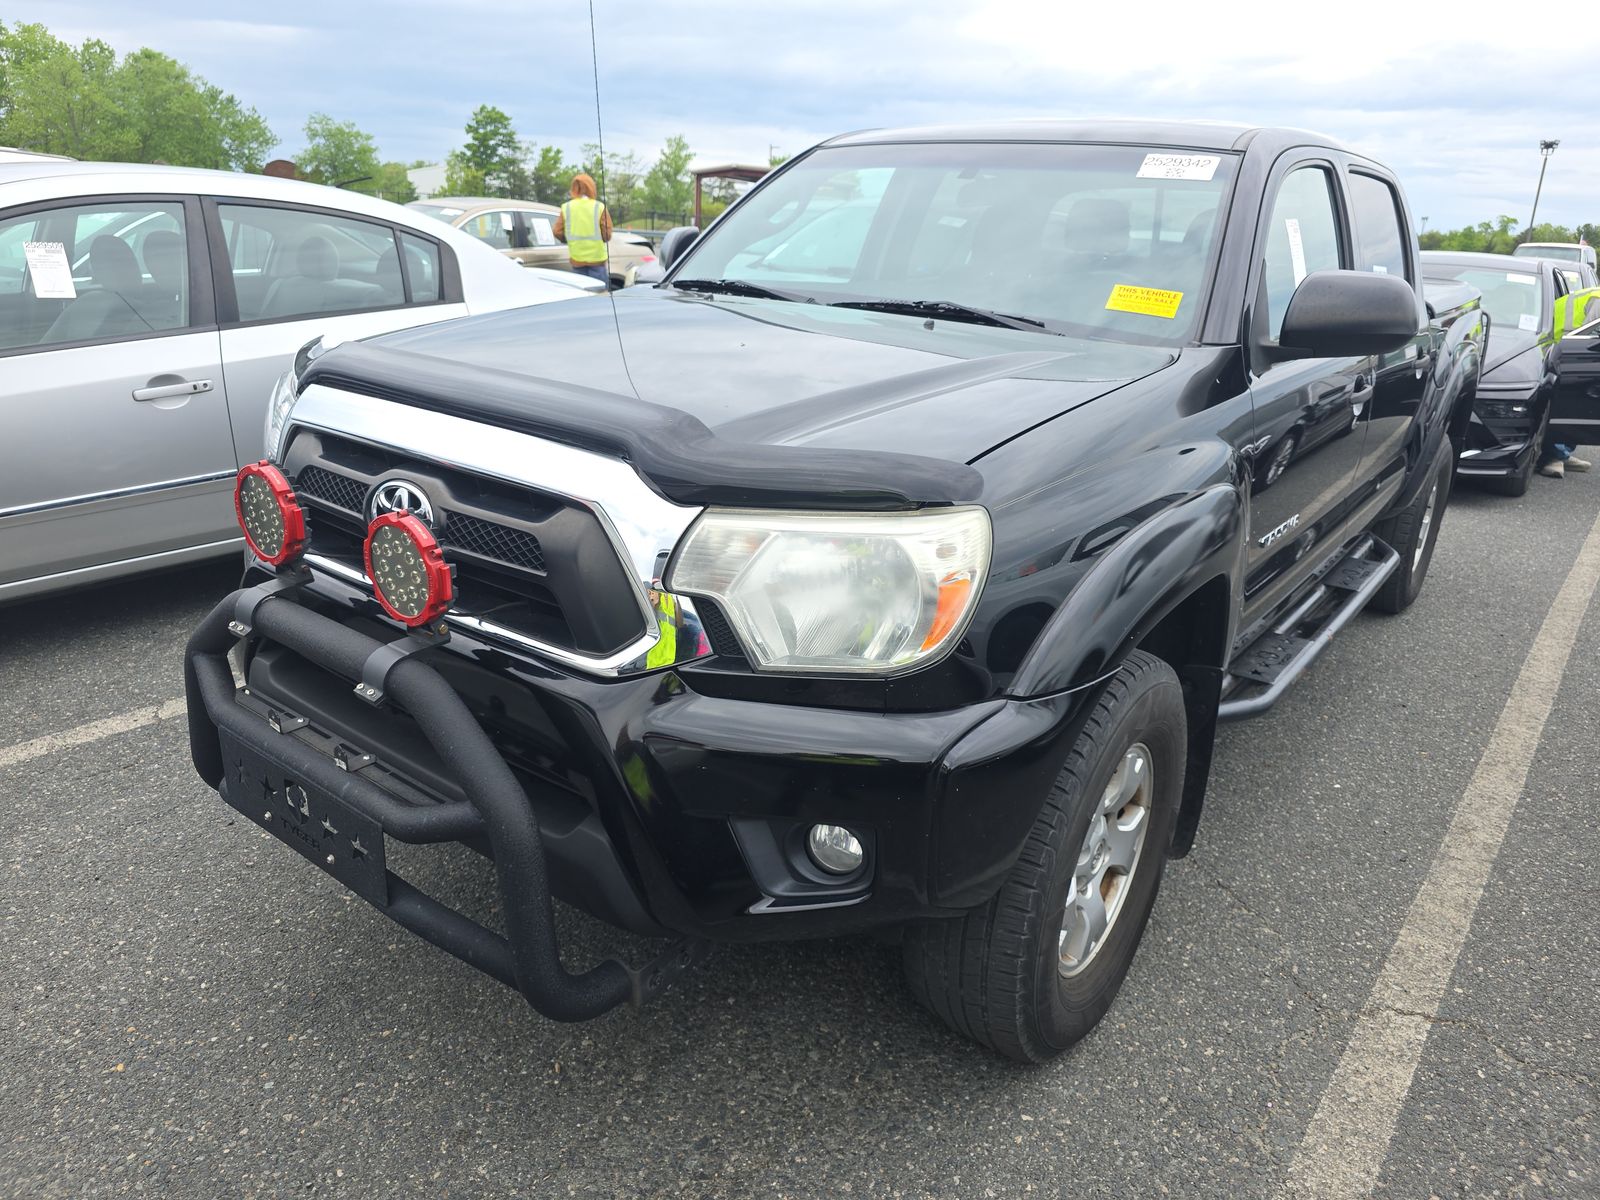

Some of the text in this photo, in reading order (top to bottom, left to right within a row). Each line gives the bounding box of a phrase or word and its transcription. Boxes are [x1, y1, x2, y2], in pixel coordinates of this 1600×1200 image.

[1145, 156, 1212, 168] 2529342
[1118, 286, 1178, 299] THIS VEHICLE
